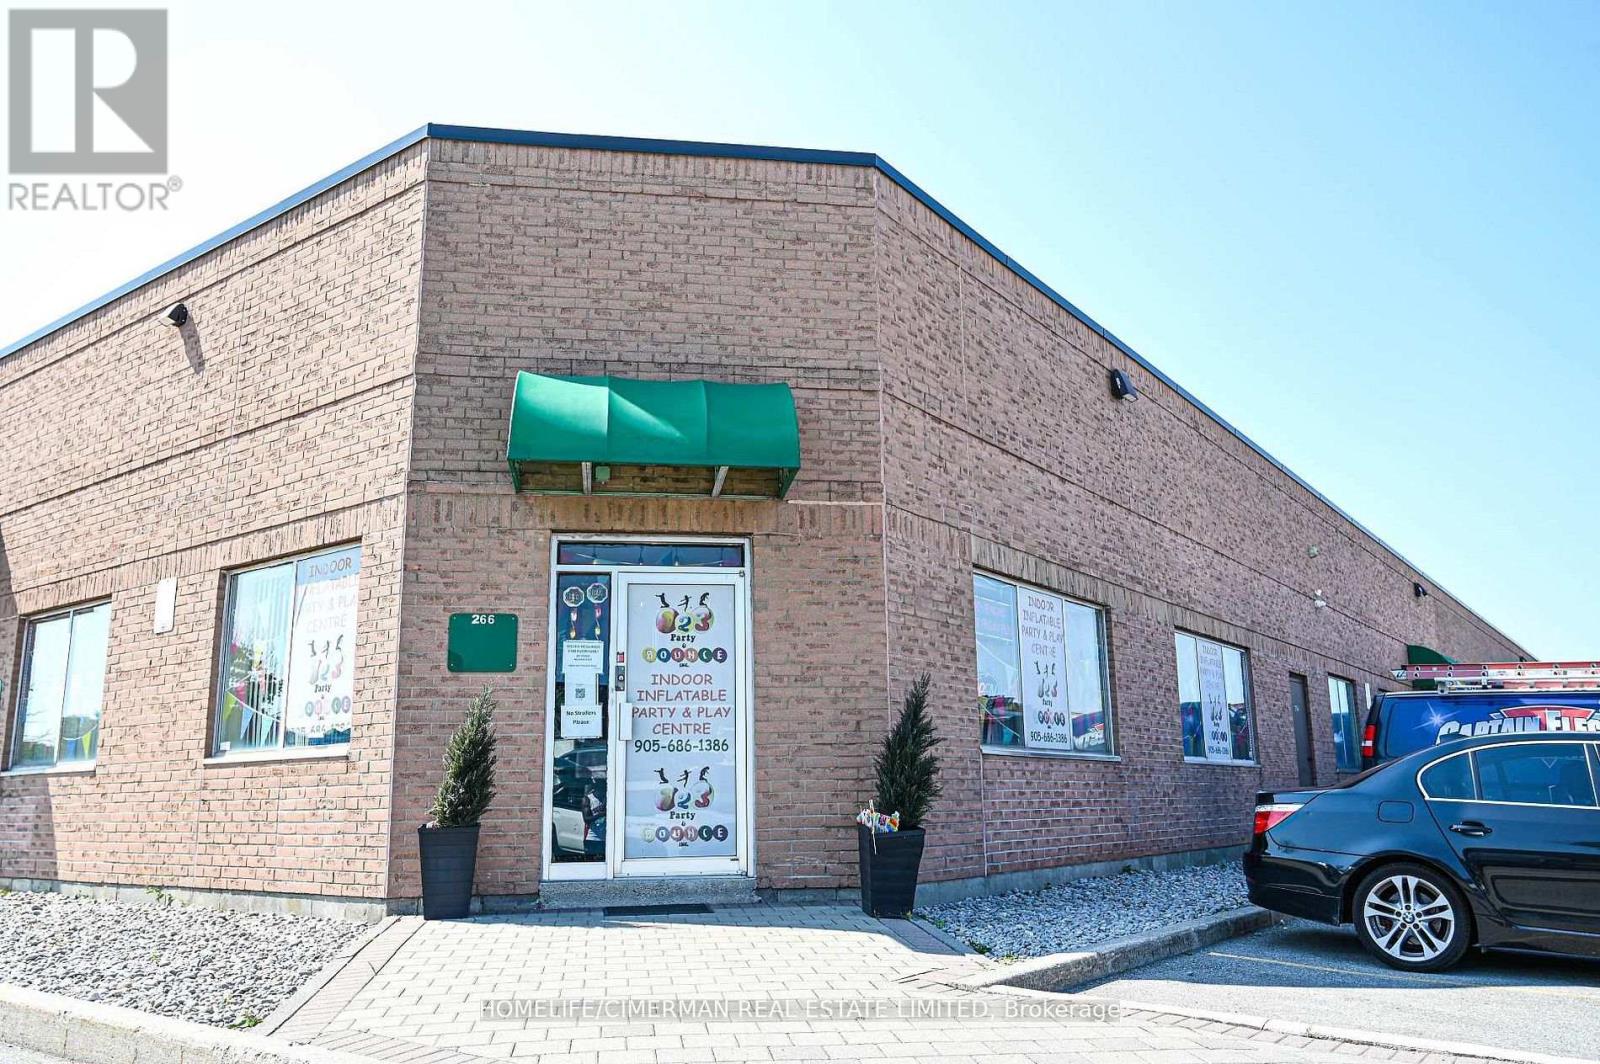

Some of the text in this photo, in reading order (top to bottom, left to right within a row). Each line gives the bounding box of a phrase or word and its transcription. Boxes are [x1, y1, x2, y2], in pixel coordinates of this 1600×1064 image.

[1028, 596, 1055, 612] INDOOR
[471, 614, 495, 624] 266
[1023, 609, 1061, 629] INFLATABLE
[670, 633, 696, 643] Party
[1021, 624, 1041, 639] PARTY
[1042, 629, 1048, 641] &
[643, 647, 727, 663] BOUNCE
[1031, 643, 1057, 658] CENTRE
[651, 674, 713, 686] INDOOR
[636, 689, 727, 701] INFLATABLE
[632, 706, 732, 718] PARTY & PLAY
[652, 723, 712, 735] CENTRE
[634, 739, 729, 753] 905-686-1386
[669, 811, 696, 821] Party
